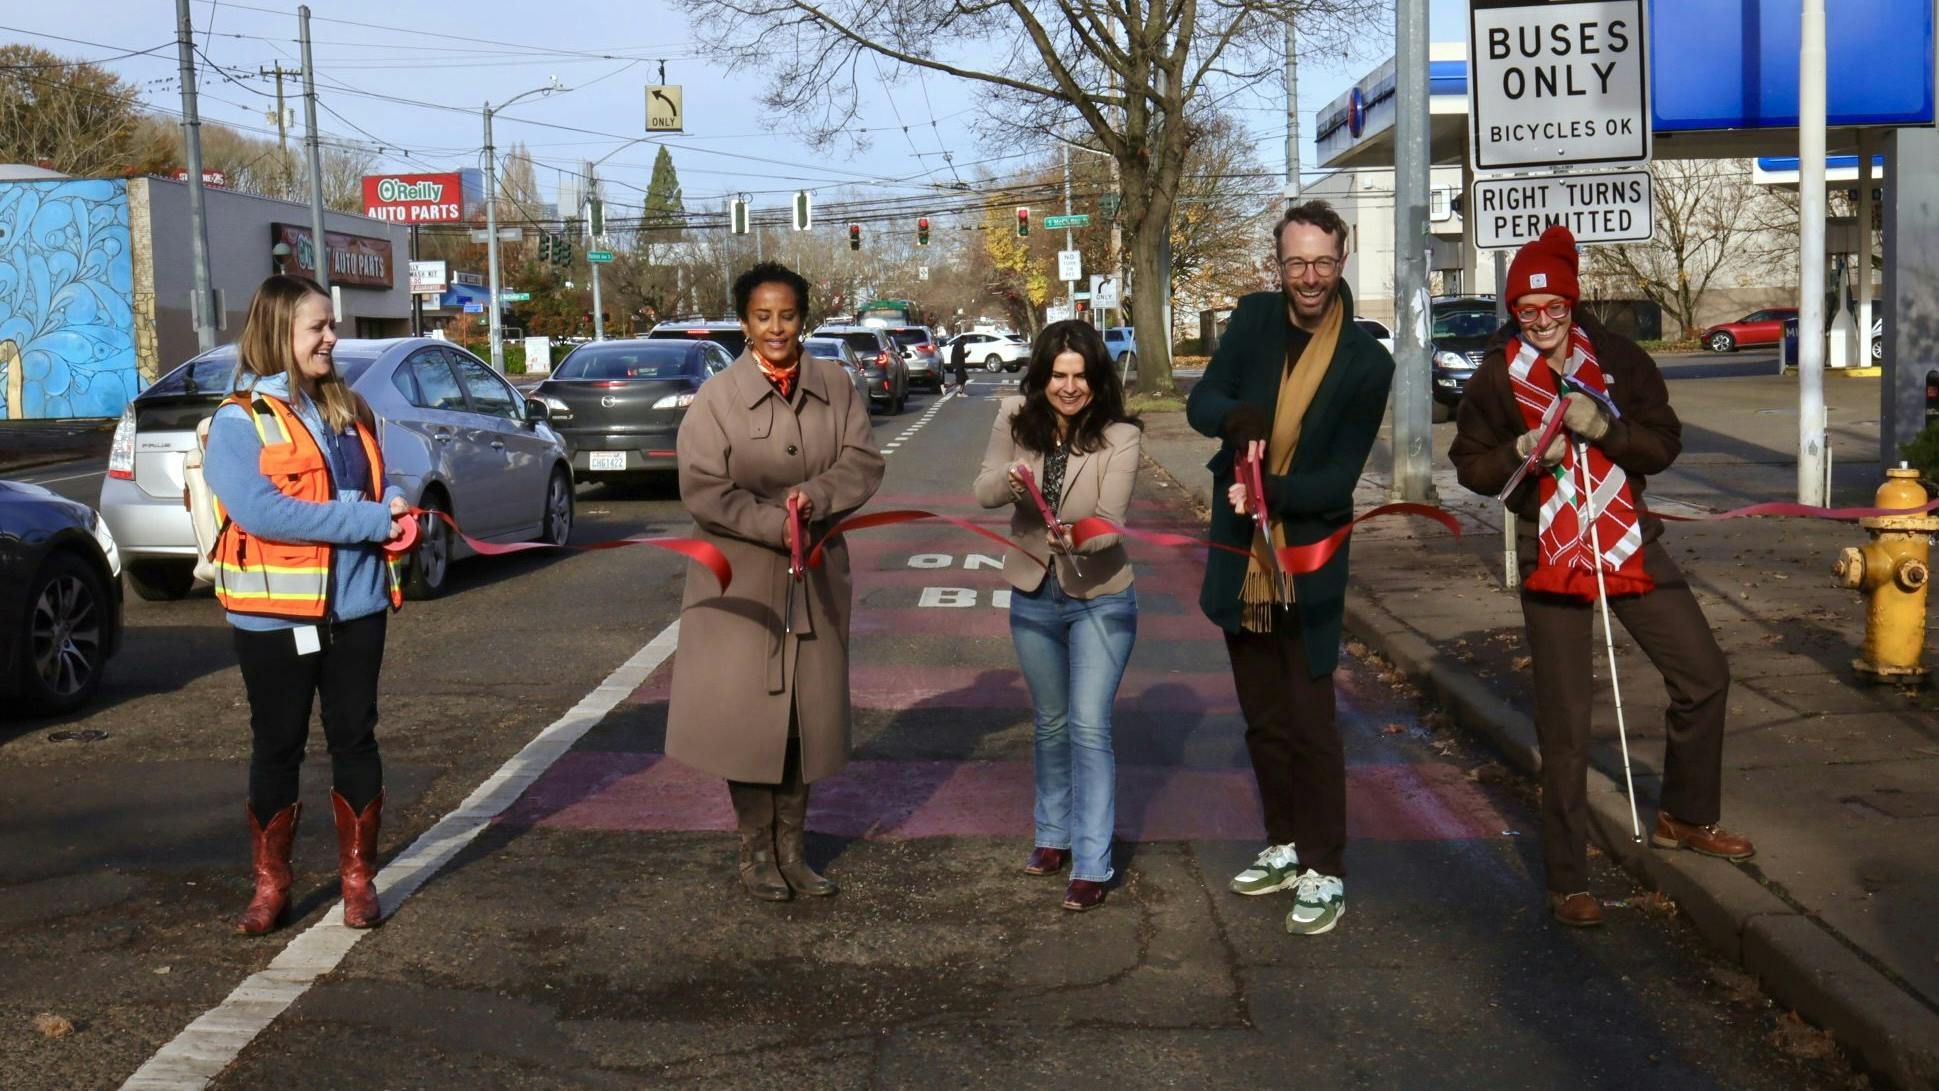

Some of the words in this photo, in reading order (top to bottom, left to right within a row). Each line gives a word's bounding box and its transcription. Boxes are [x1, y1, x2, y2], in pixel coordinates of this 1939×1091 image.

[1489, 20, 1629, 60] BUSES
[1503, 62, 1616, 100] ONLY
[652, 117, 675, 127] ONLY
[1491, 120, 1596, 142] BICYCLES
[1606, 118, 1632, 136] OK
[379, 179, 443, 202] O'Reilly
[1483, 186, 1549, 211] RIGHT
[1566, 181, 1641, 207] TURNS
[368, 206, 406, 220] AUTO
[411, 204, 459, 220] PARTS
[1495, 209, 1632, 239] PERMITTED
[335, 251, 357, 274] AUTO
[360, 254, 385, 277] PARTS
